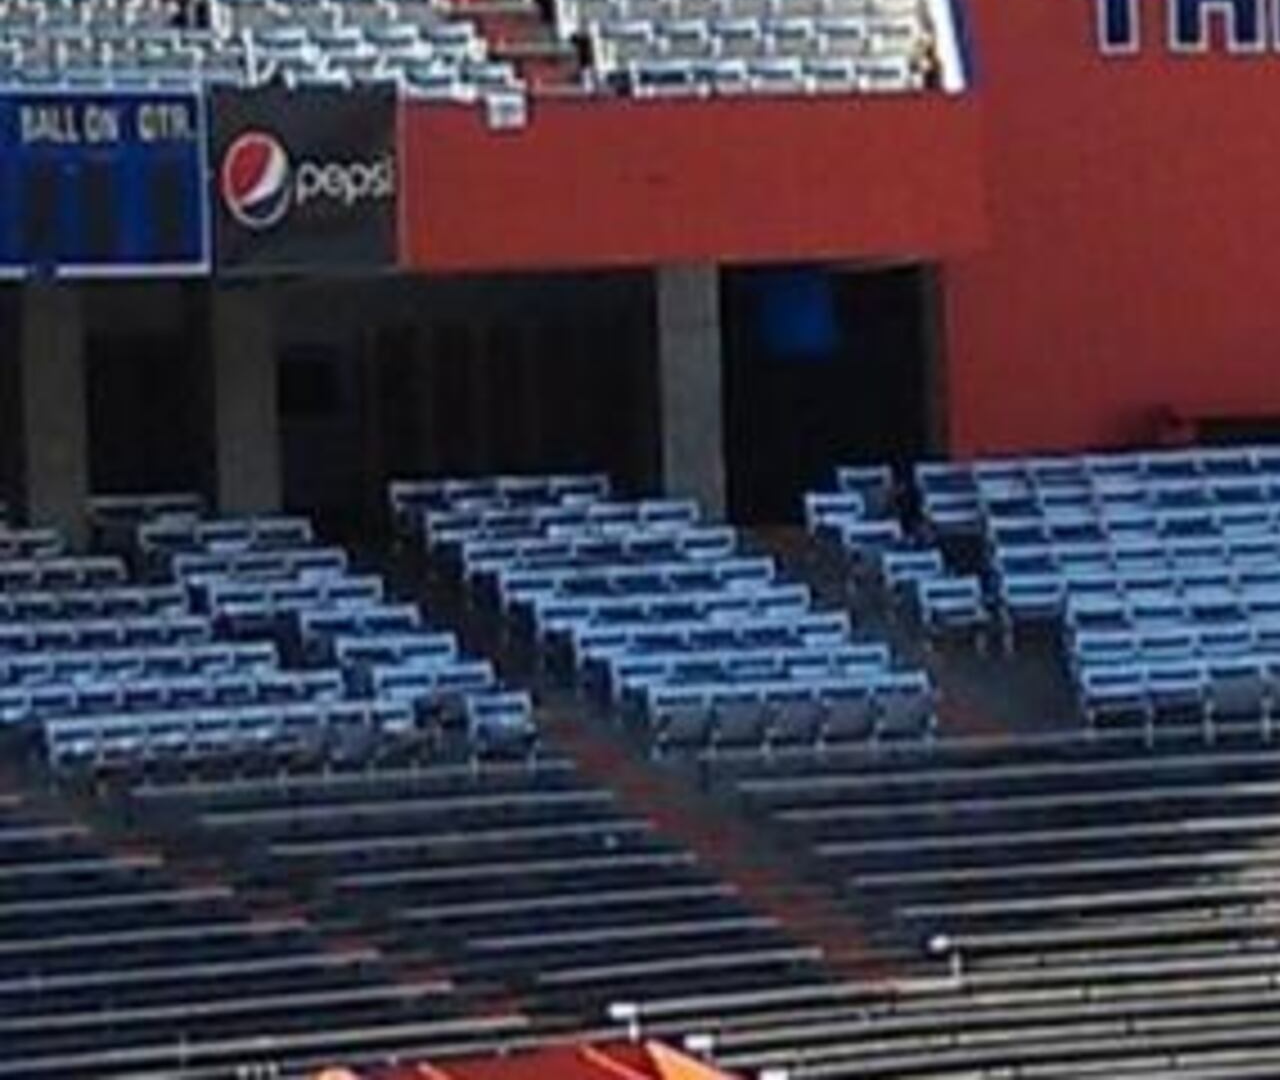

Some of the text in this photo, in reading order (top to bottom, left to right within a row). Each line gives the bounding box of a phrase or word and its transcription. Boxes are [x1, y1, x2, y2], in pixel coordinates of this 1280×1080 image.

[20, 104, 119, 142] BALL ON
[296, 154, 394, 205] pepsi
